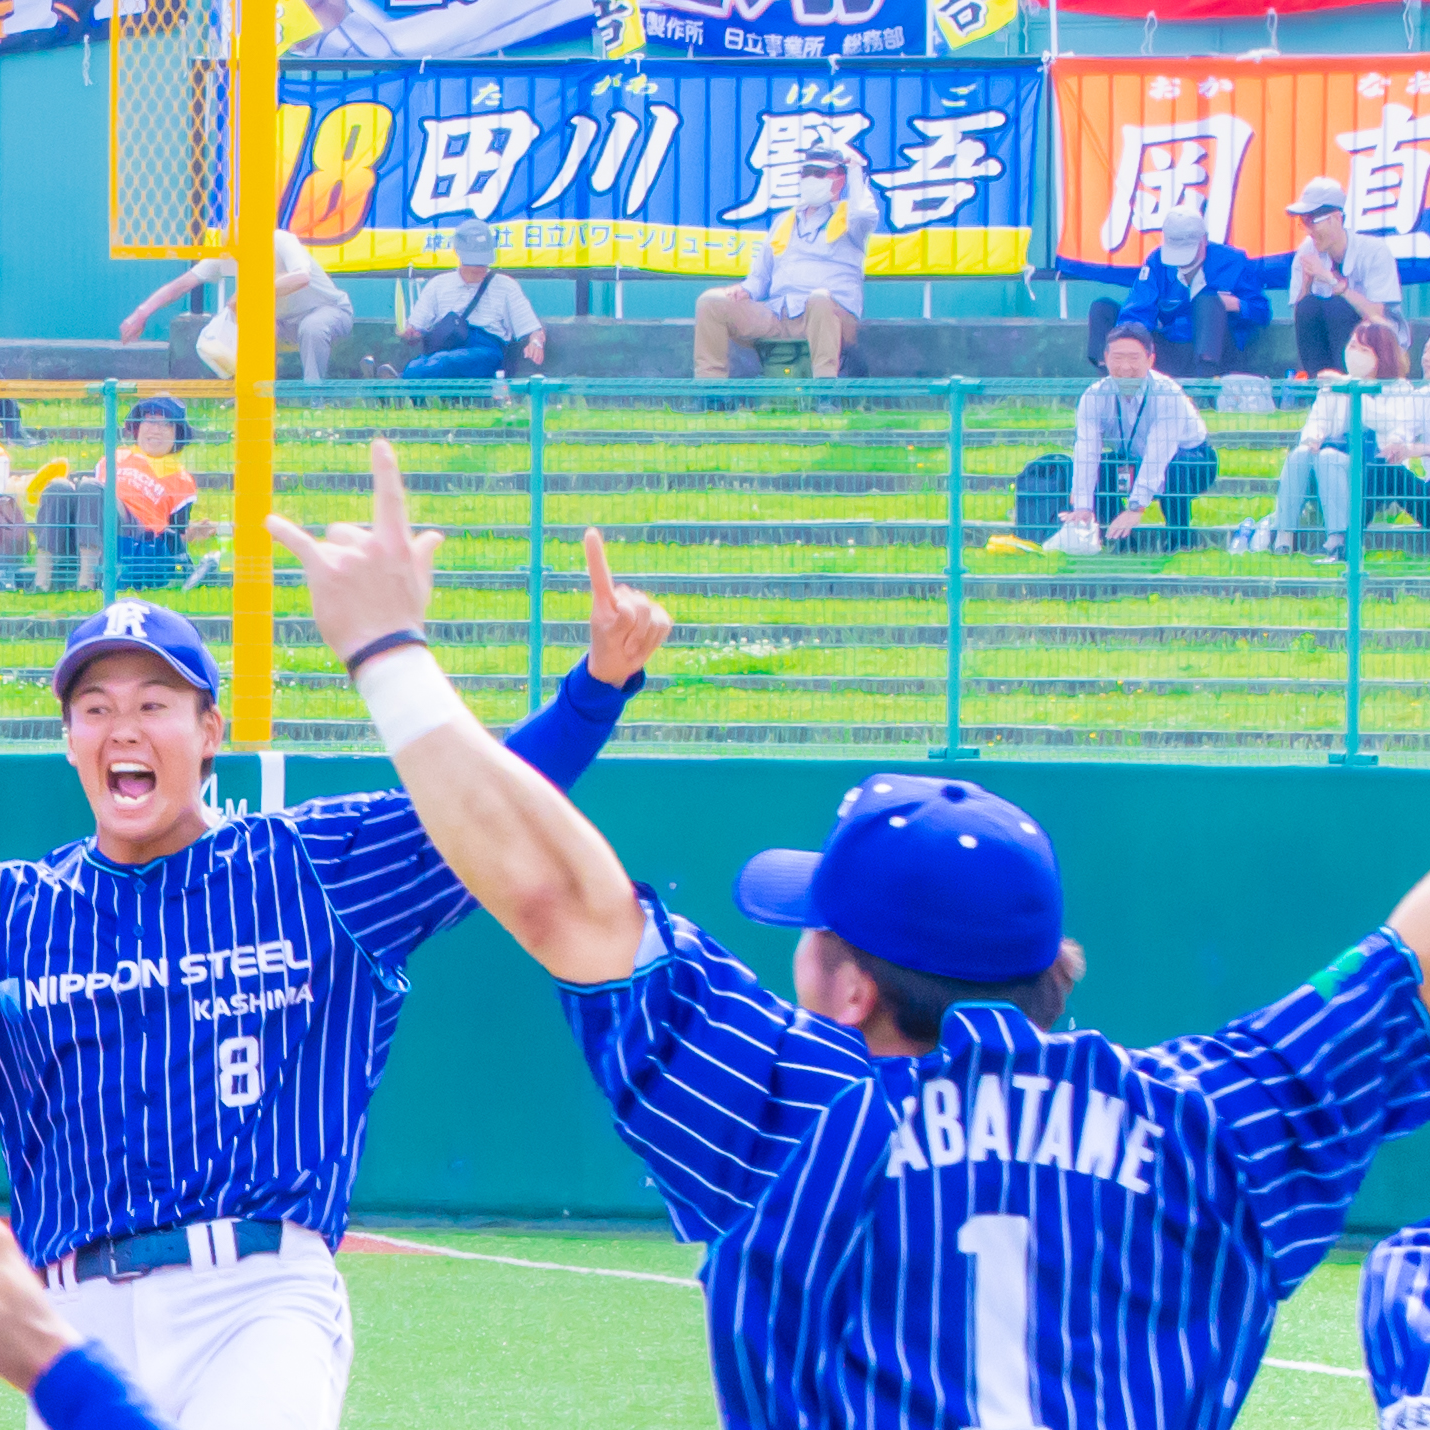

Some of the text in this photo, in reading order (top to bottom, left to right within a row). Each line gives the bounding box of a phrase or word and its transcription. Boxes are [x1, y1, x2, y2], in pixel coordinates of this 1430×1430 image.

[646, 11, 704, 45] 製作所
[1148, 74, 1234, 100] おか
[409, 104, 680, 220] 田川
[1099, 114, 1254, 252] 岡
[25, 939, 312, 1010] NIPPON STEEL
[193, 982, 314, 1023] KASHIMA
[218, 1035, 265, 1109] 8
